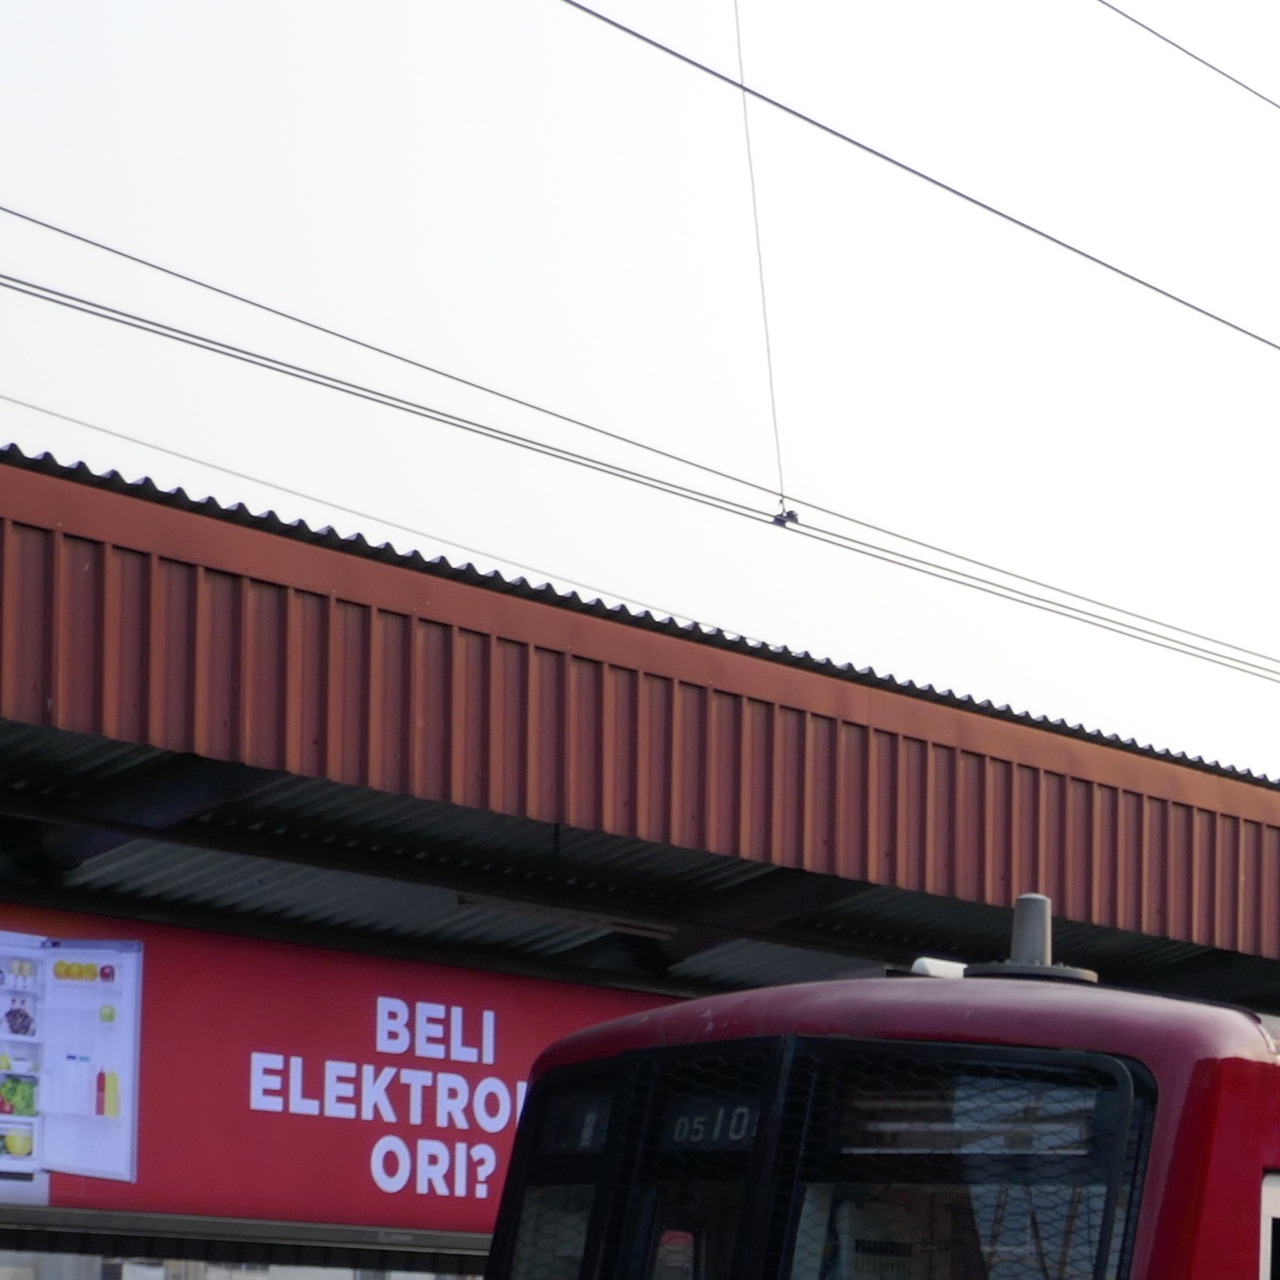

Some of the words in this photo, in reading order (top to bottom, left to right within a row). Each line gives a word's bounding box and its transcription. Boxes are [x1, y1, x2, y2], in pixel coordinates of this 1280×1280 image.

[376, 996, 496, 1065] BELI
[250, 1052, 527, 1134] ELEKTRO
[370, 1135, 497, 1200] ORI?
